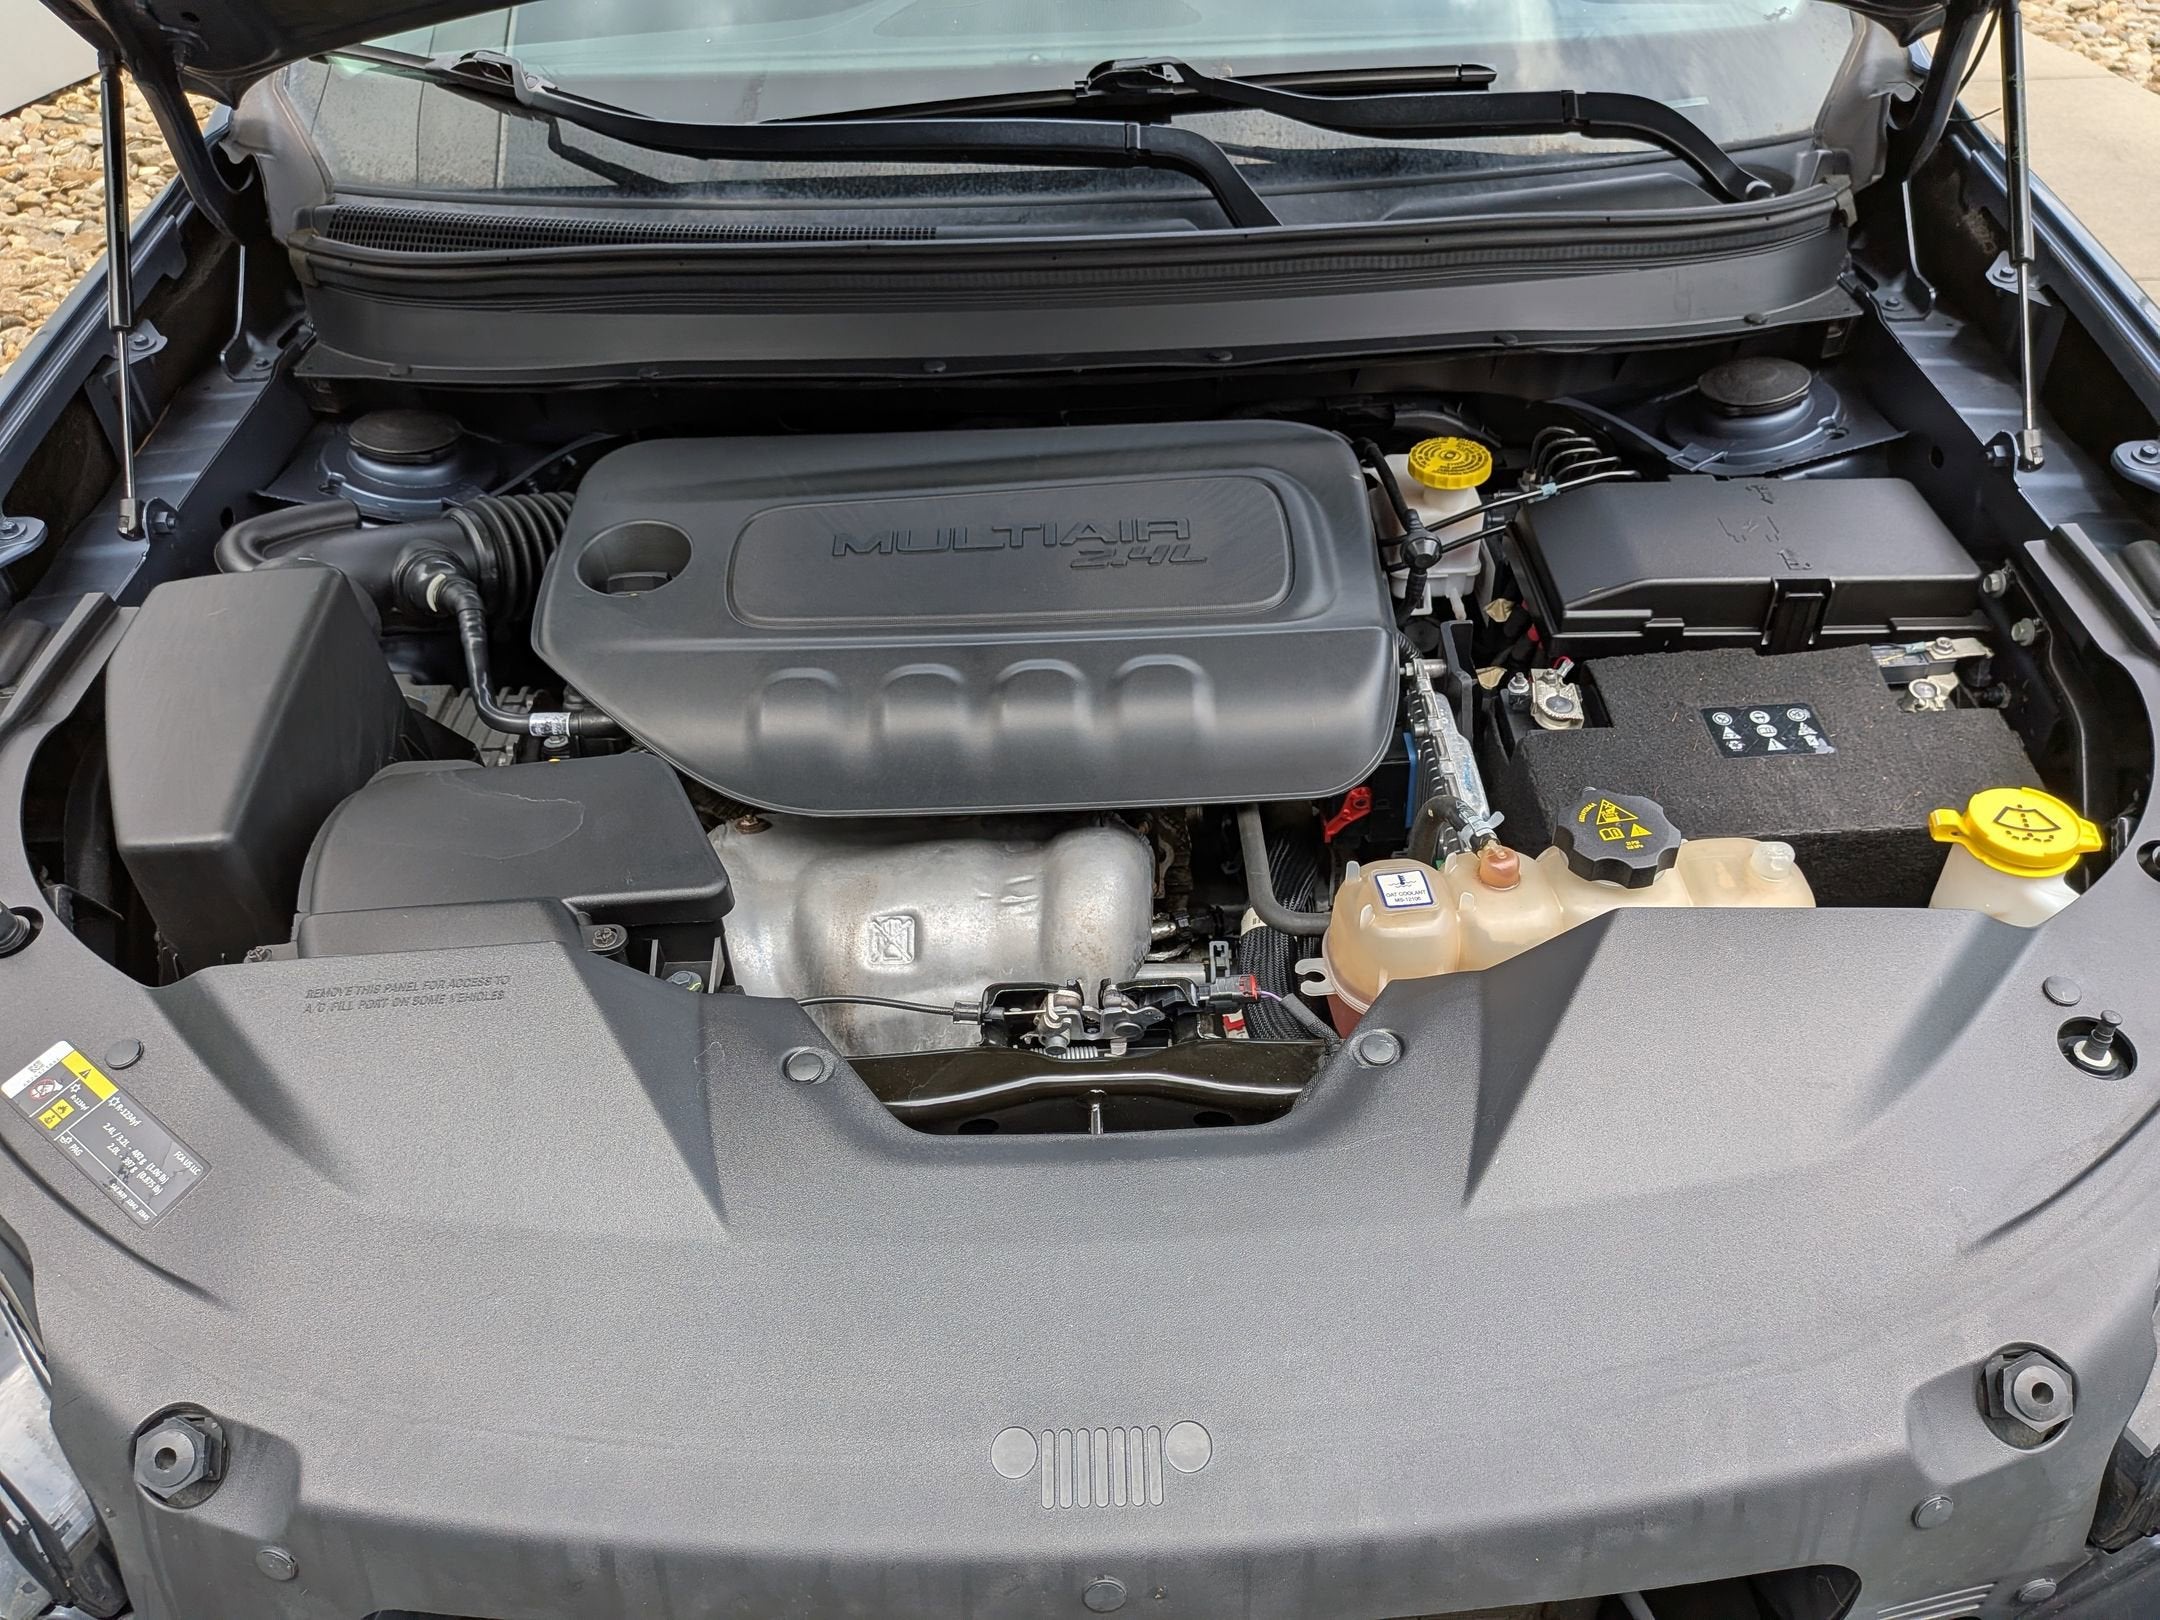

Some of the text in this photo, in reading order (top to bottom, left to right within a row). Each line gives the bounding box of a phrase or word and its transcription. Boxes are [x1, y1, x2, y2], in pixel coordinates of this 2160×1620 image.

[832, 517, 1190, 557] MULTIAIR
[1069, 543, 1208, 569] 2.4L
[1398, 889, 1426, 897] COOLANT
[305, 975, 511, 999] REMOVE THIS PANEL FOR ACCESS TO
[303, 989, 505, 1014] A/C FILL PORT ON SOME VEHICLES
[115, 1103, 142, 1127] R-1234yf
[68, 1143, 84, 1157] PAG
[103, 1122, 116, 1136] 2.4L
[116, 1134, 130, 1148] 3.2L
[131, 1149, 145, 1162] 482
[107, 1142, 121, 1156] 2.0L
[121, 1157, 136, 1169] 397
[173, 1150, 201, 1176] FCA US LLC
